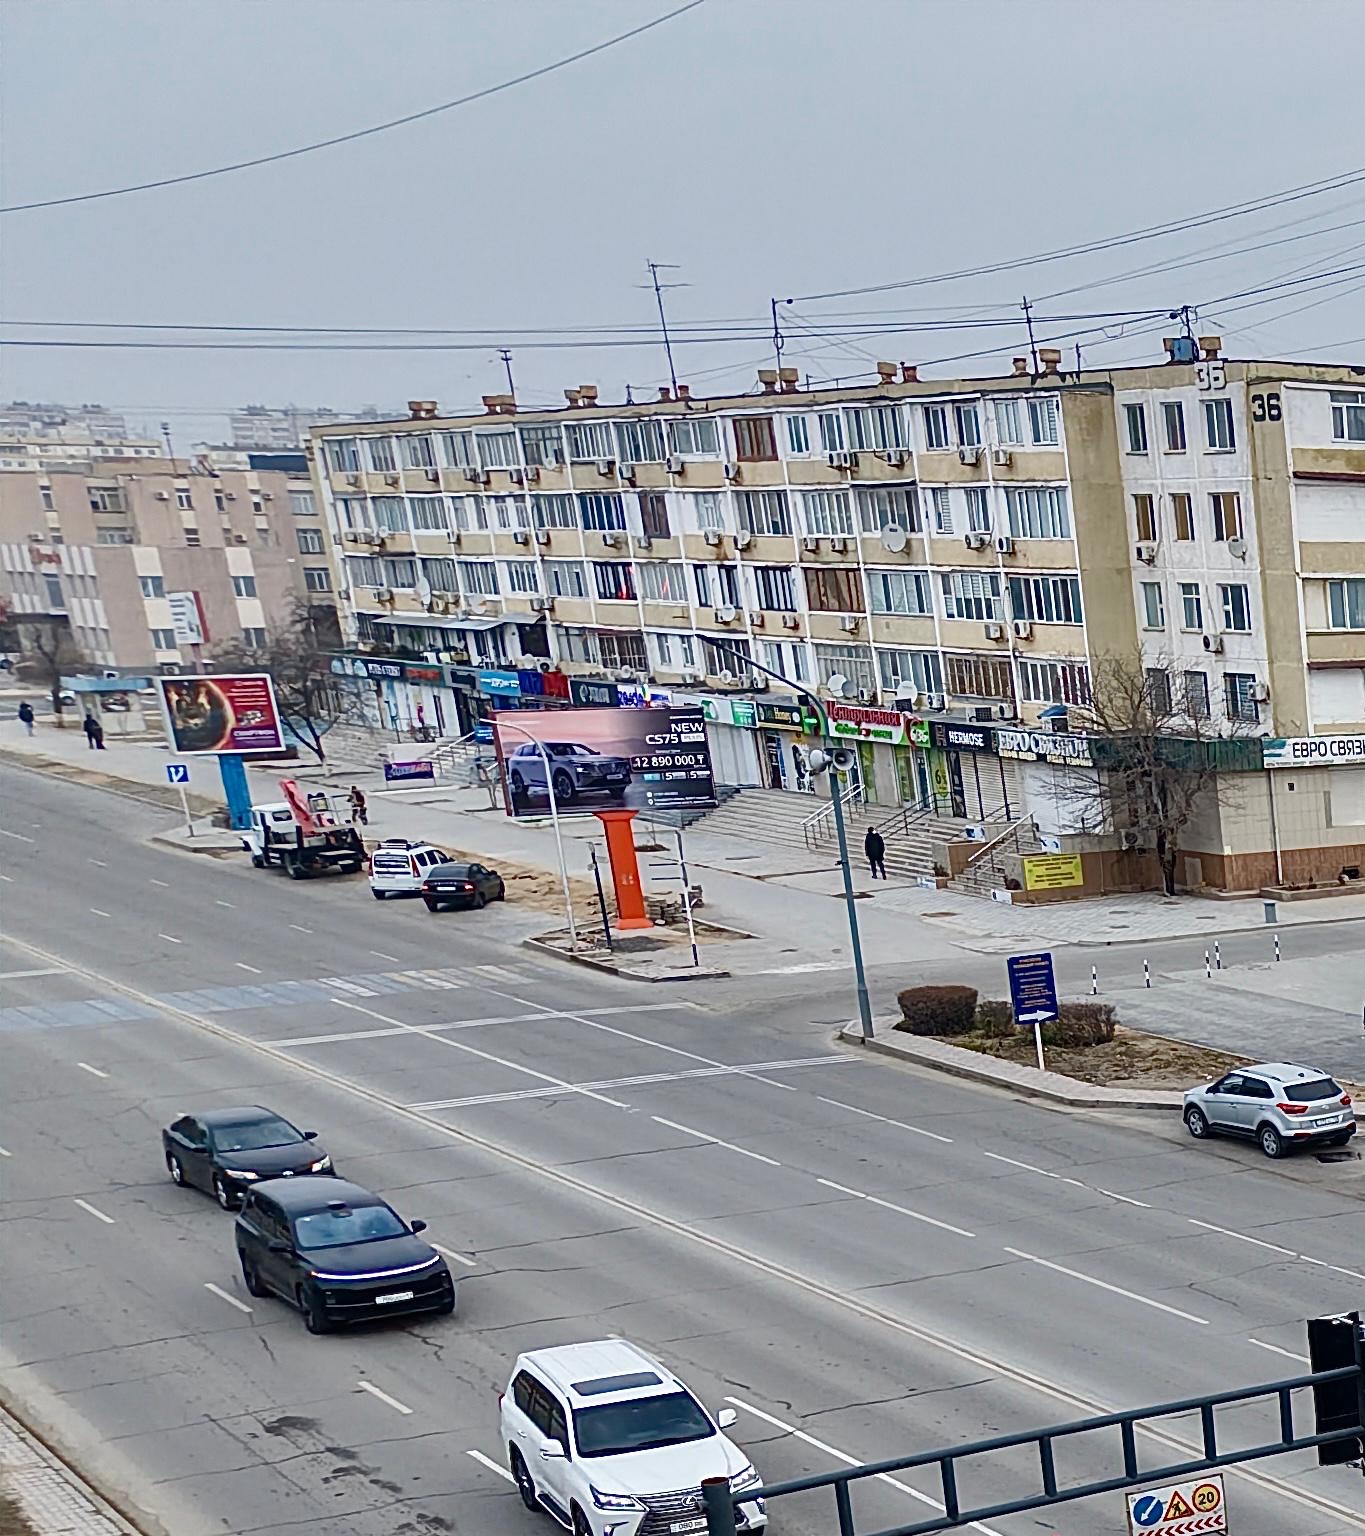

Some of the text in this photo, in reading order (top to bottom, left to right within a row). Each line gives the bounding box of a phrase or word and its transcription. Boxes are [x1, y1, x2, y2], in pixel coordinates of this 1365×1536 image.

[1194, 361, 1226, 391] 36
[1251, 392, 1282, 422] 36
[671, 723, 704, 733] NEW
[645, 734, 679, 745] CS75
[1292, 741, 1328, 759] ЕВРО
[651, 756, 673, 767] 890
[674, 754, 695, 766] 000
[1197, 1491, 1215, 1505] 20
